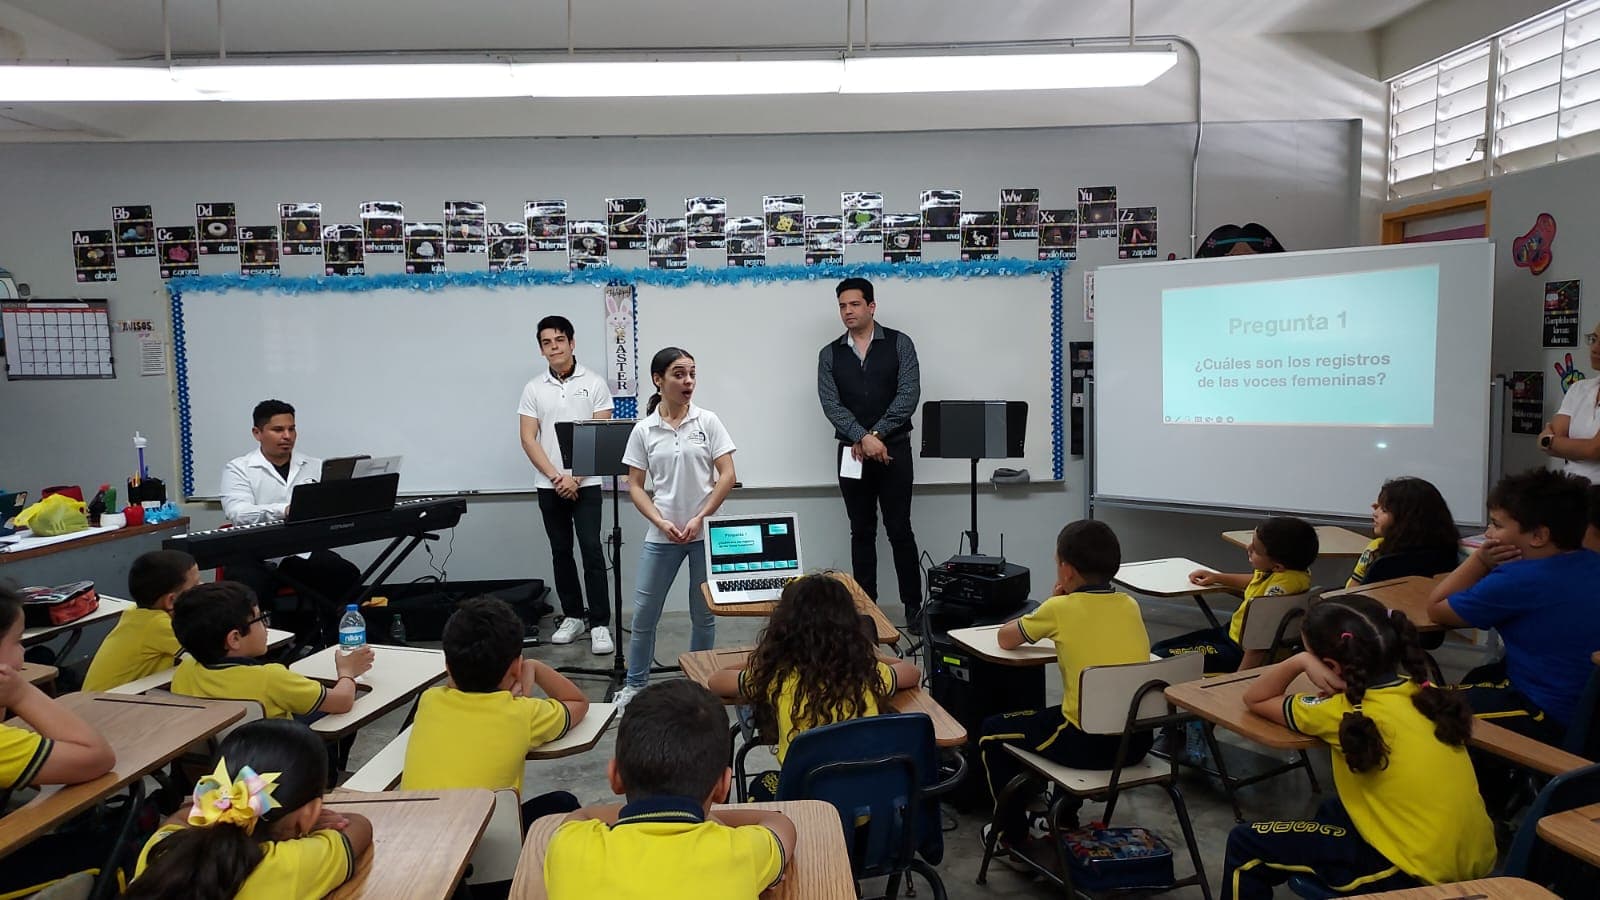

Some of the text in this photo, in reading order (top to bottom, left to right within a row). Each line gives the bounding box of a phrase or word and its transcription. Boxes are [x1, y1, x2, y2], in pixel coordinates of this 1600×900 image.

[1002, 190, 1022, 202] Ww
[1079, 189, 1093, 204] Yy
[197, 204, 212, 216] Dd
[608, 201, 624, 212] Nn
[113, 208, 130, 220] Bb
[1040, 211, 1056, 223] Xx
[1119, 209, 1135, 221] Zz
[158, 228, 174, 240] Cc
[240, 227, 254, 239] Ee
[488, 224, 503, 236] Kk
[74, 232, 90, 244] Aa
[1229, 311, 1348, 336] Pregunta 1
[1195, 353, 1391, 373] ¿Cuáles son los registros
[1198, 372, 1386, 388] de las voces femeninas?
